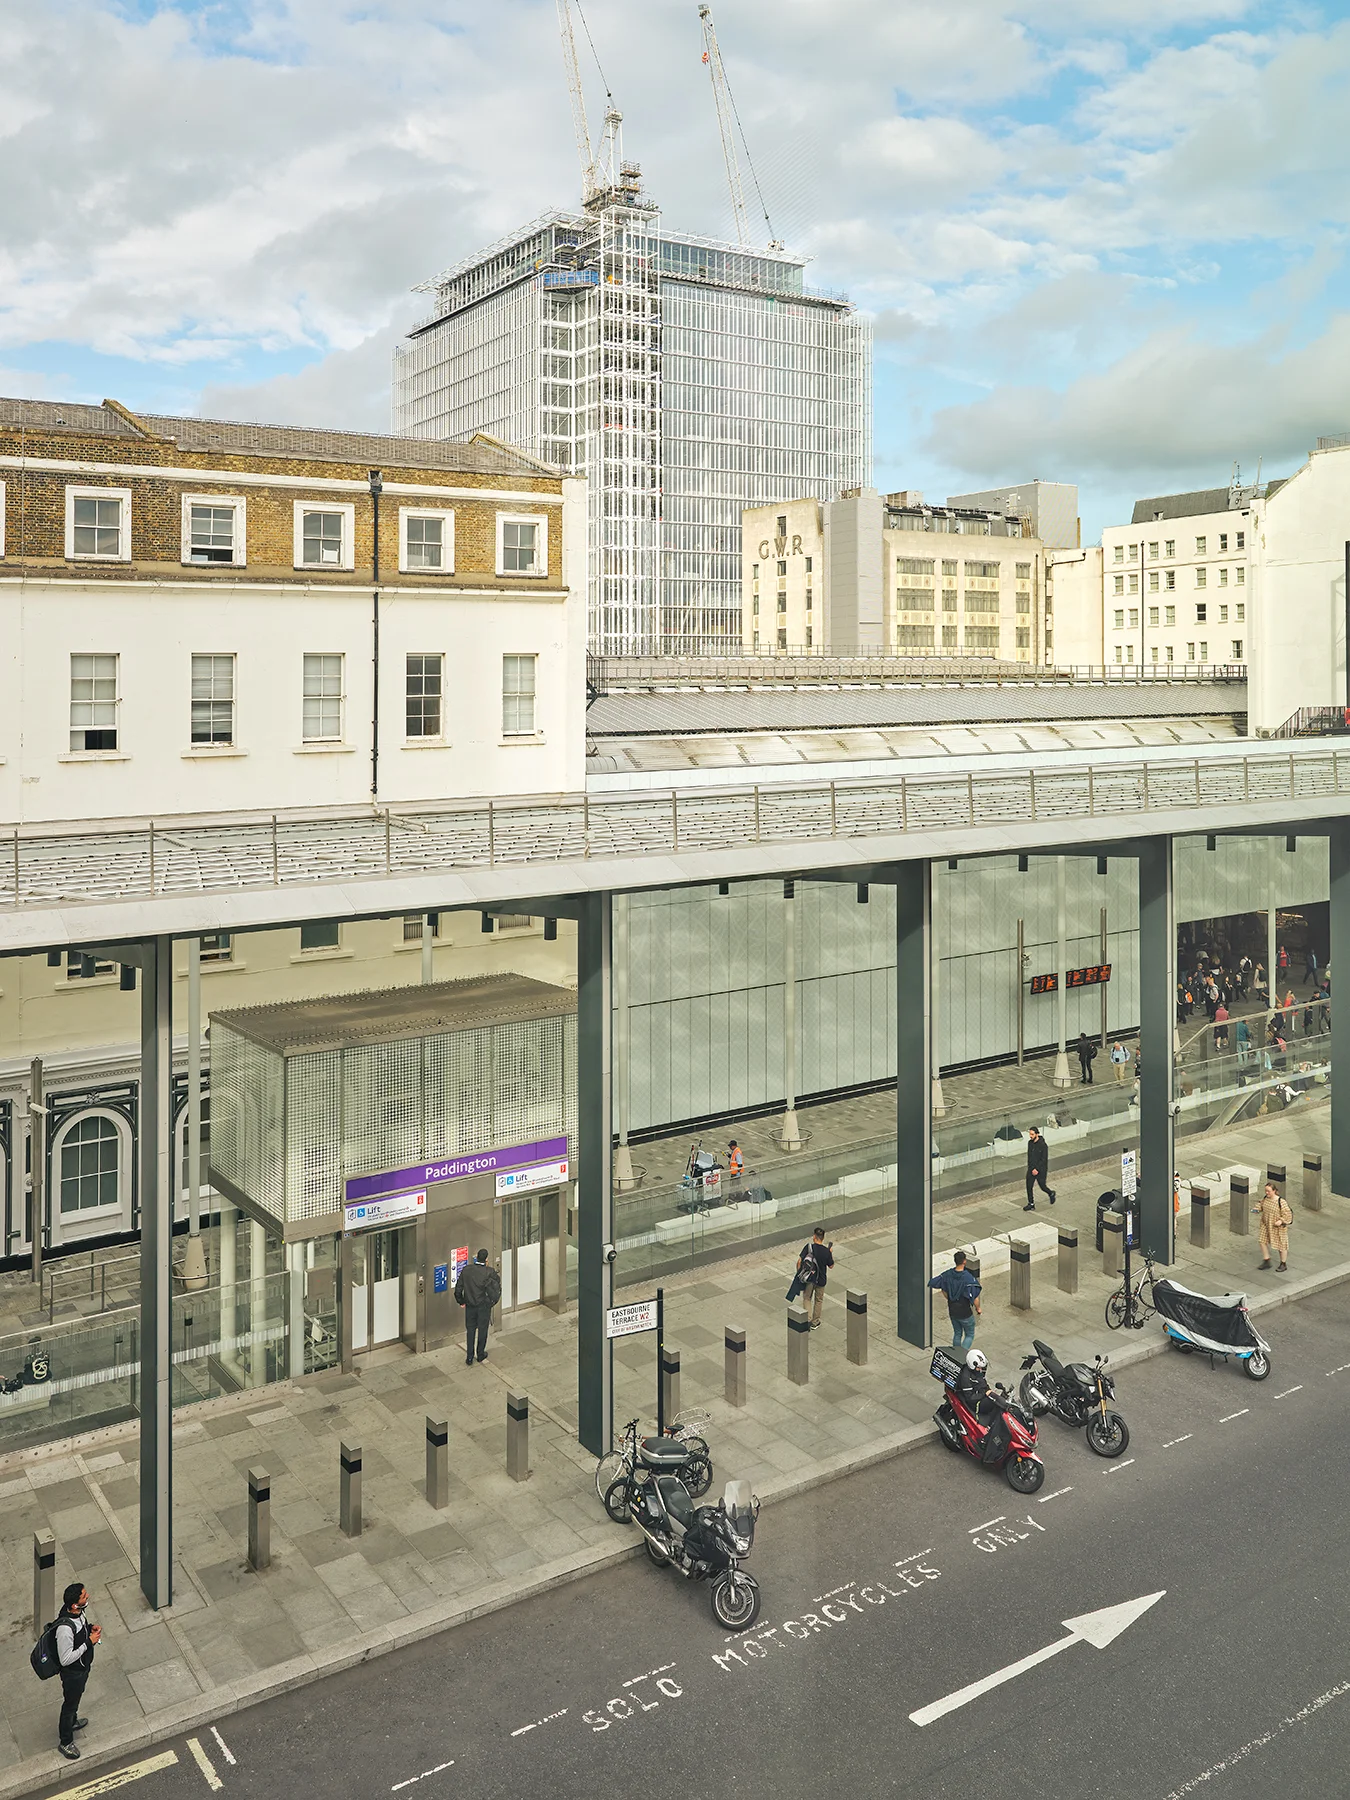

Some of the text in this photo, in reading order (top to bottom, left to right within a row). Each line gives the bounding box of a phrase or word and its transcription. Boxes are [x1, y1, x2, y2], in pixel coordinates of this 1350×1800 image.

[425, 1156, 497, 1180] Paddington
[515, 1173, 528, 1183] Lift
[367, 1205, 381, 1215] Lift
[611, 1304, 651, 1319] EASTBOURNE
[611, 1312, 650, 1326] TERRACE W2
[582, 1515, 1046, 1732] SOLO MOTORCYCLES ONLY
